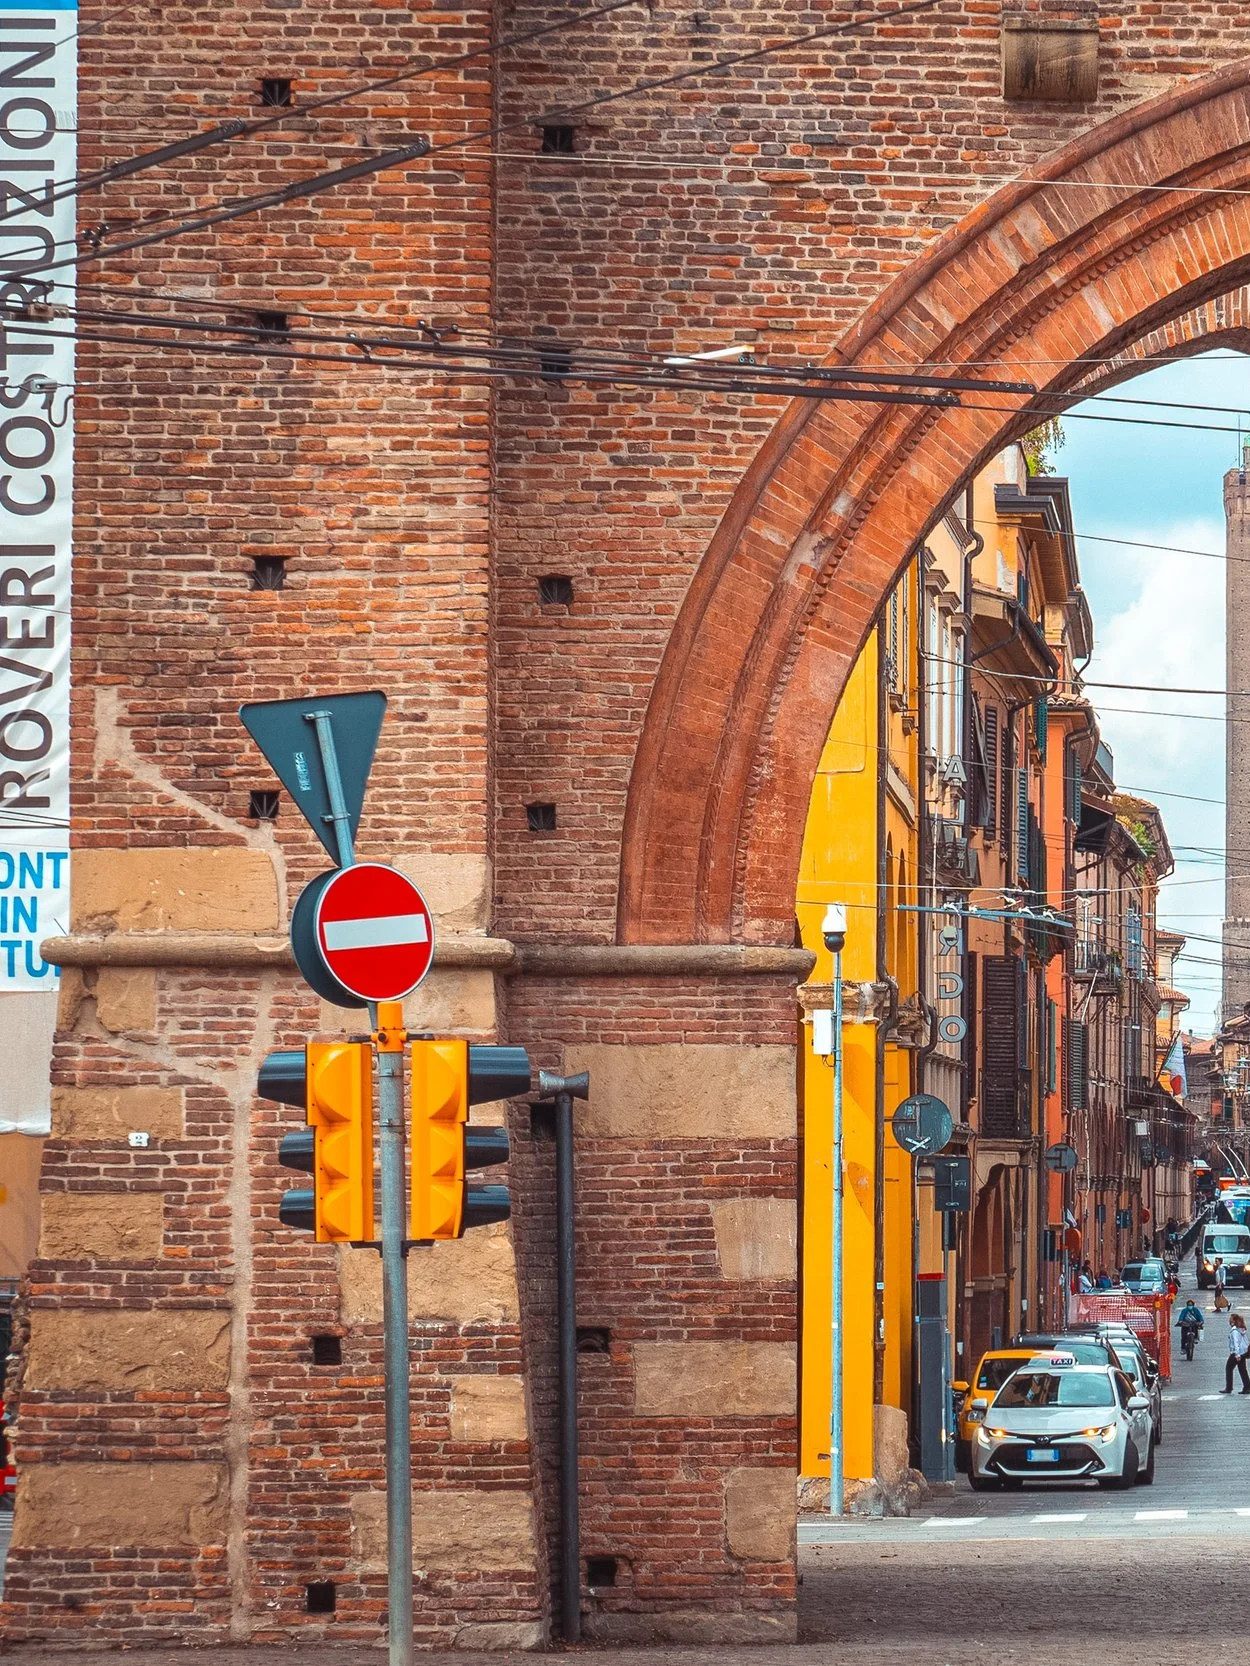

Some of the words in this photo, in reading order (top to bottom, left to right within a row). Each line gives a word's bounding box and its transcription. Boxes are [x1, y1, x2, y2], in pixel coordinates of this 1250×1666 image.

[0, 18, 56, 517] COSTRUZIONI
[0, 544, 56, 808] ROVERI
[0, 940, 61, 978] TU
